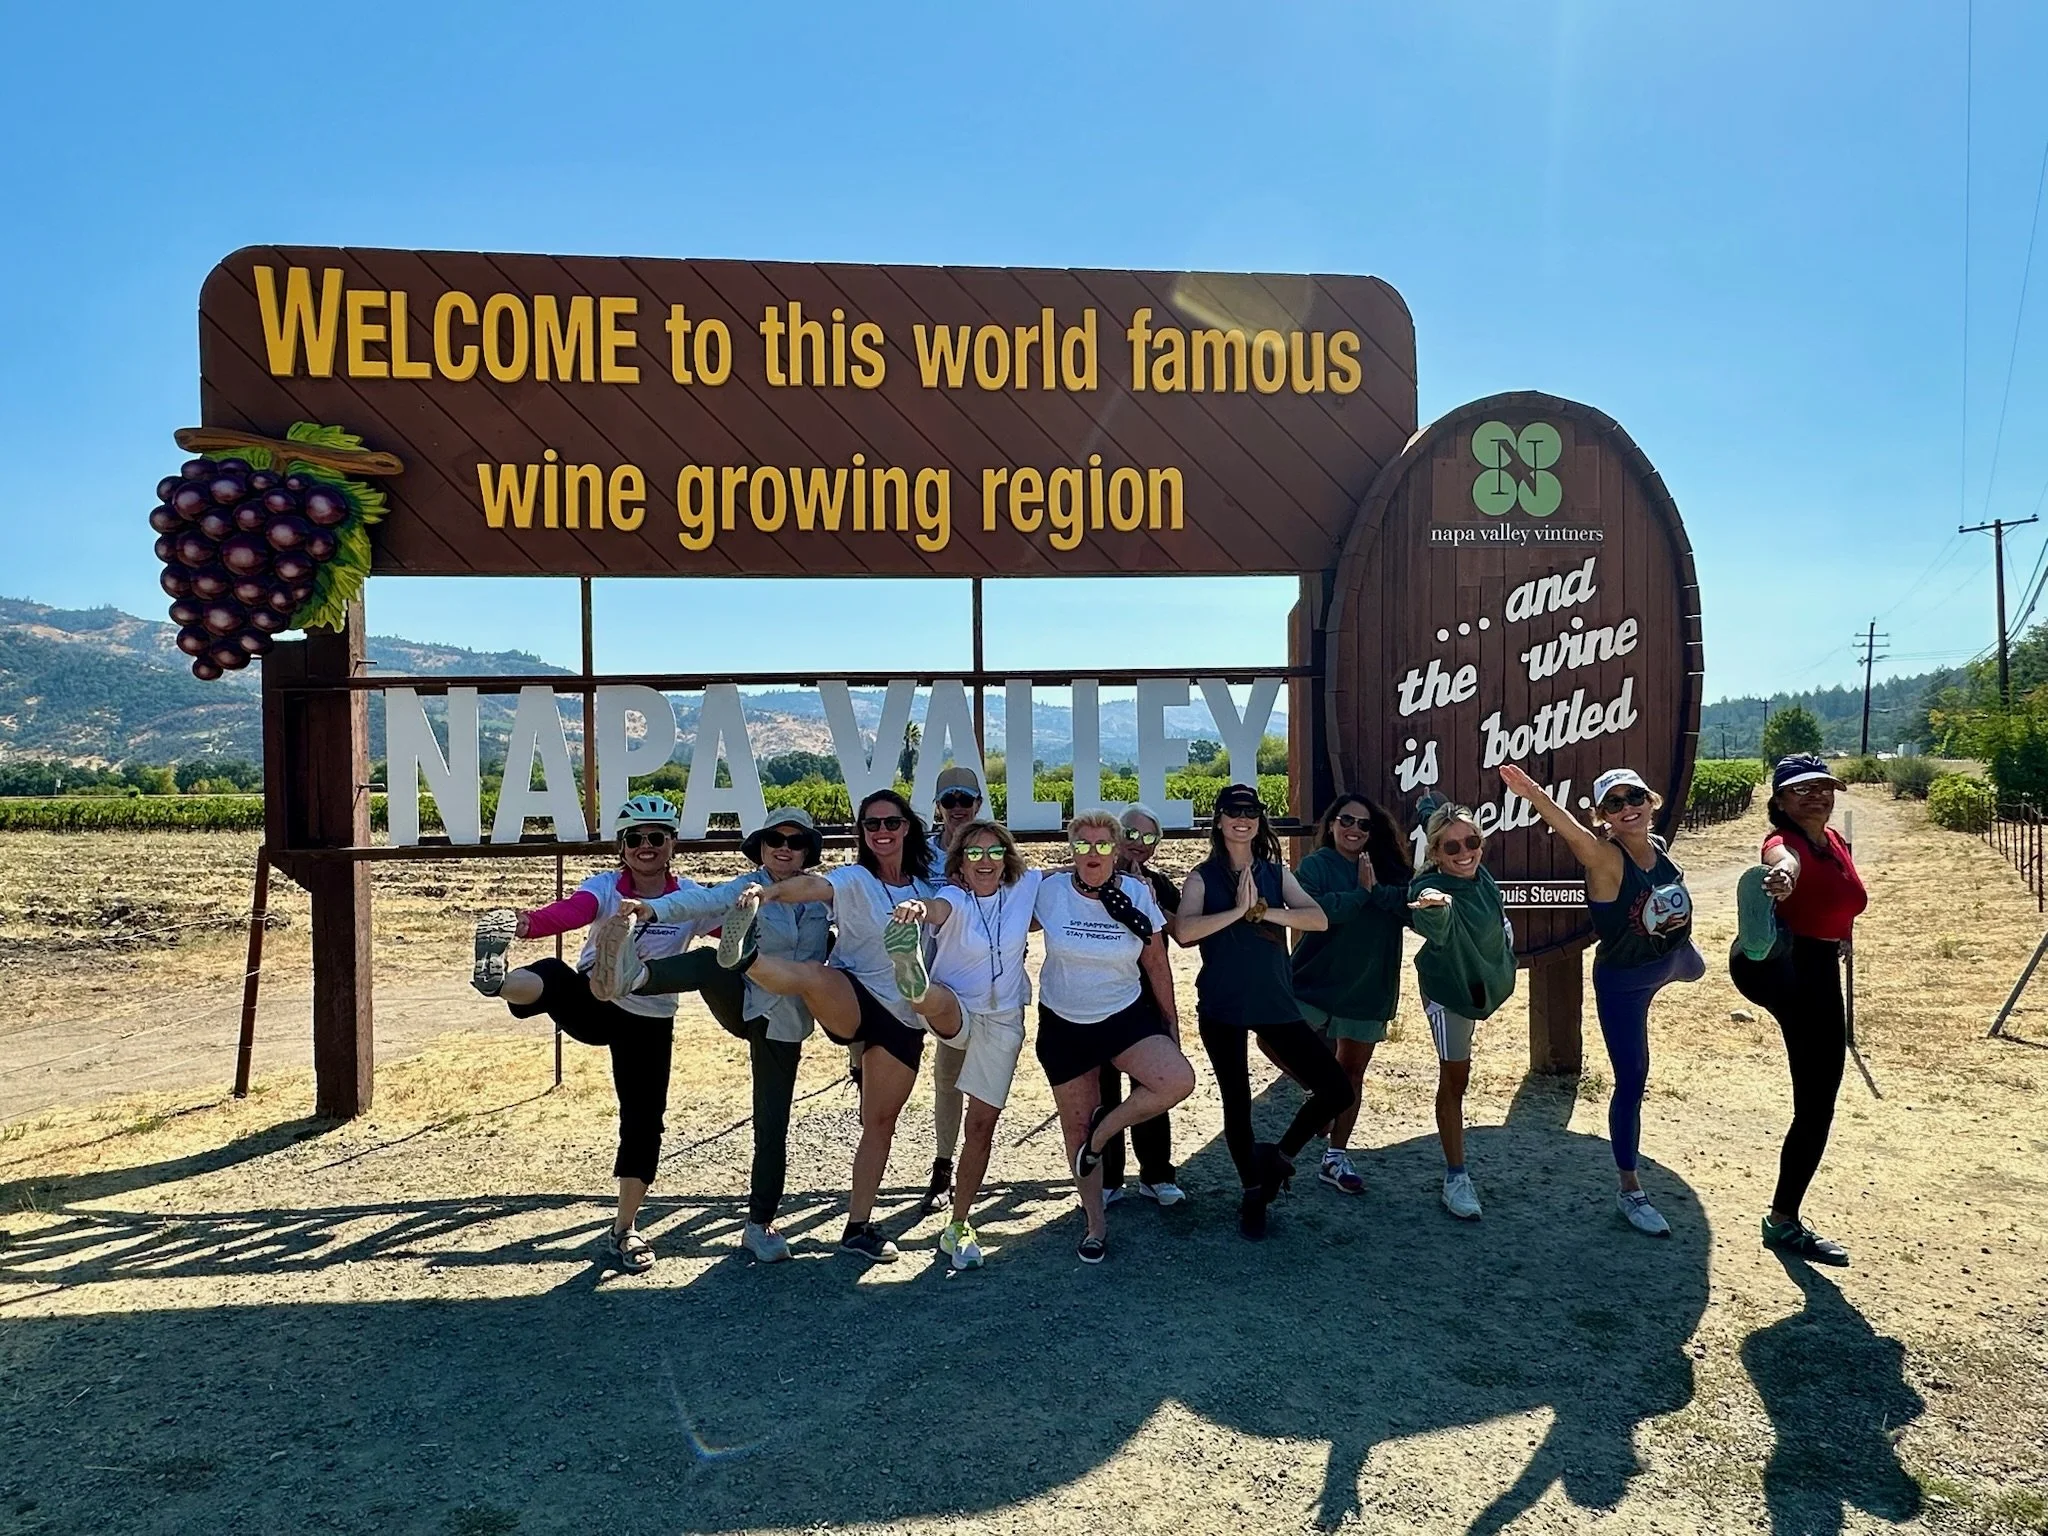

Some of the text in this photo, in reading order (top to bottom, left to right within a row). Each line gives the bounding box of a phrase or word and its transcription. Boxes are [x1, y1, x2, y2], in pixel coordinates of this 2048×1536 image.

[253, 265, 1363, 394] WELCOME to this world famous
[477, 448, 1185, 553] wine growing region
[1431, 522, 1605, 547] napa valley vintners
[1397, 616, 1639, 717] the wine
[384, 677, 1285, 847] NAPA VALLEY
[1394, 676, 1639, 793] is bottled
[1066, 930, 1122, 941] STAY PRESENT
[1083, 921, 1120, 929] HAPPENS
[1499, 885, 1586, 903] ouis Stevens
